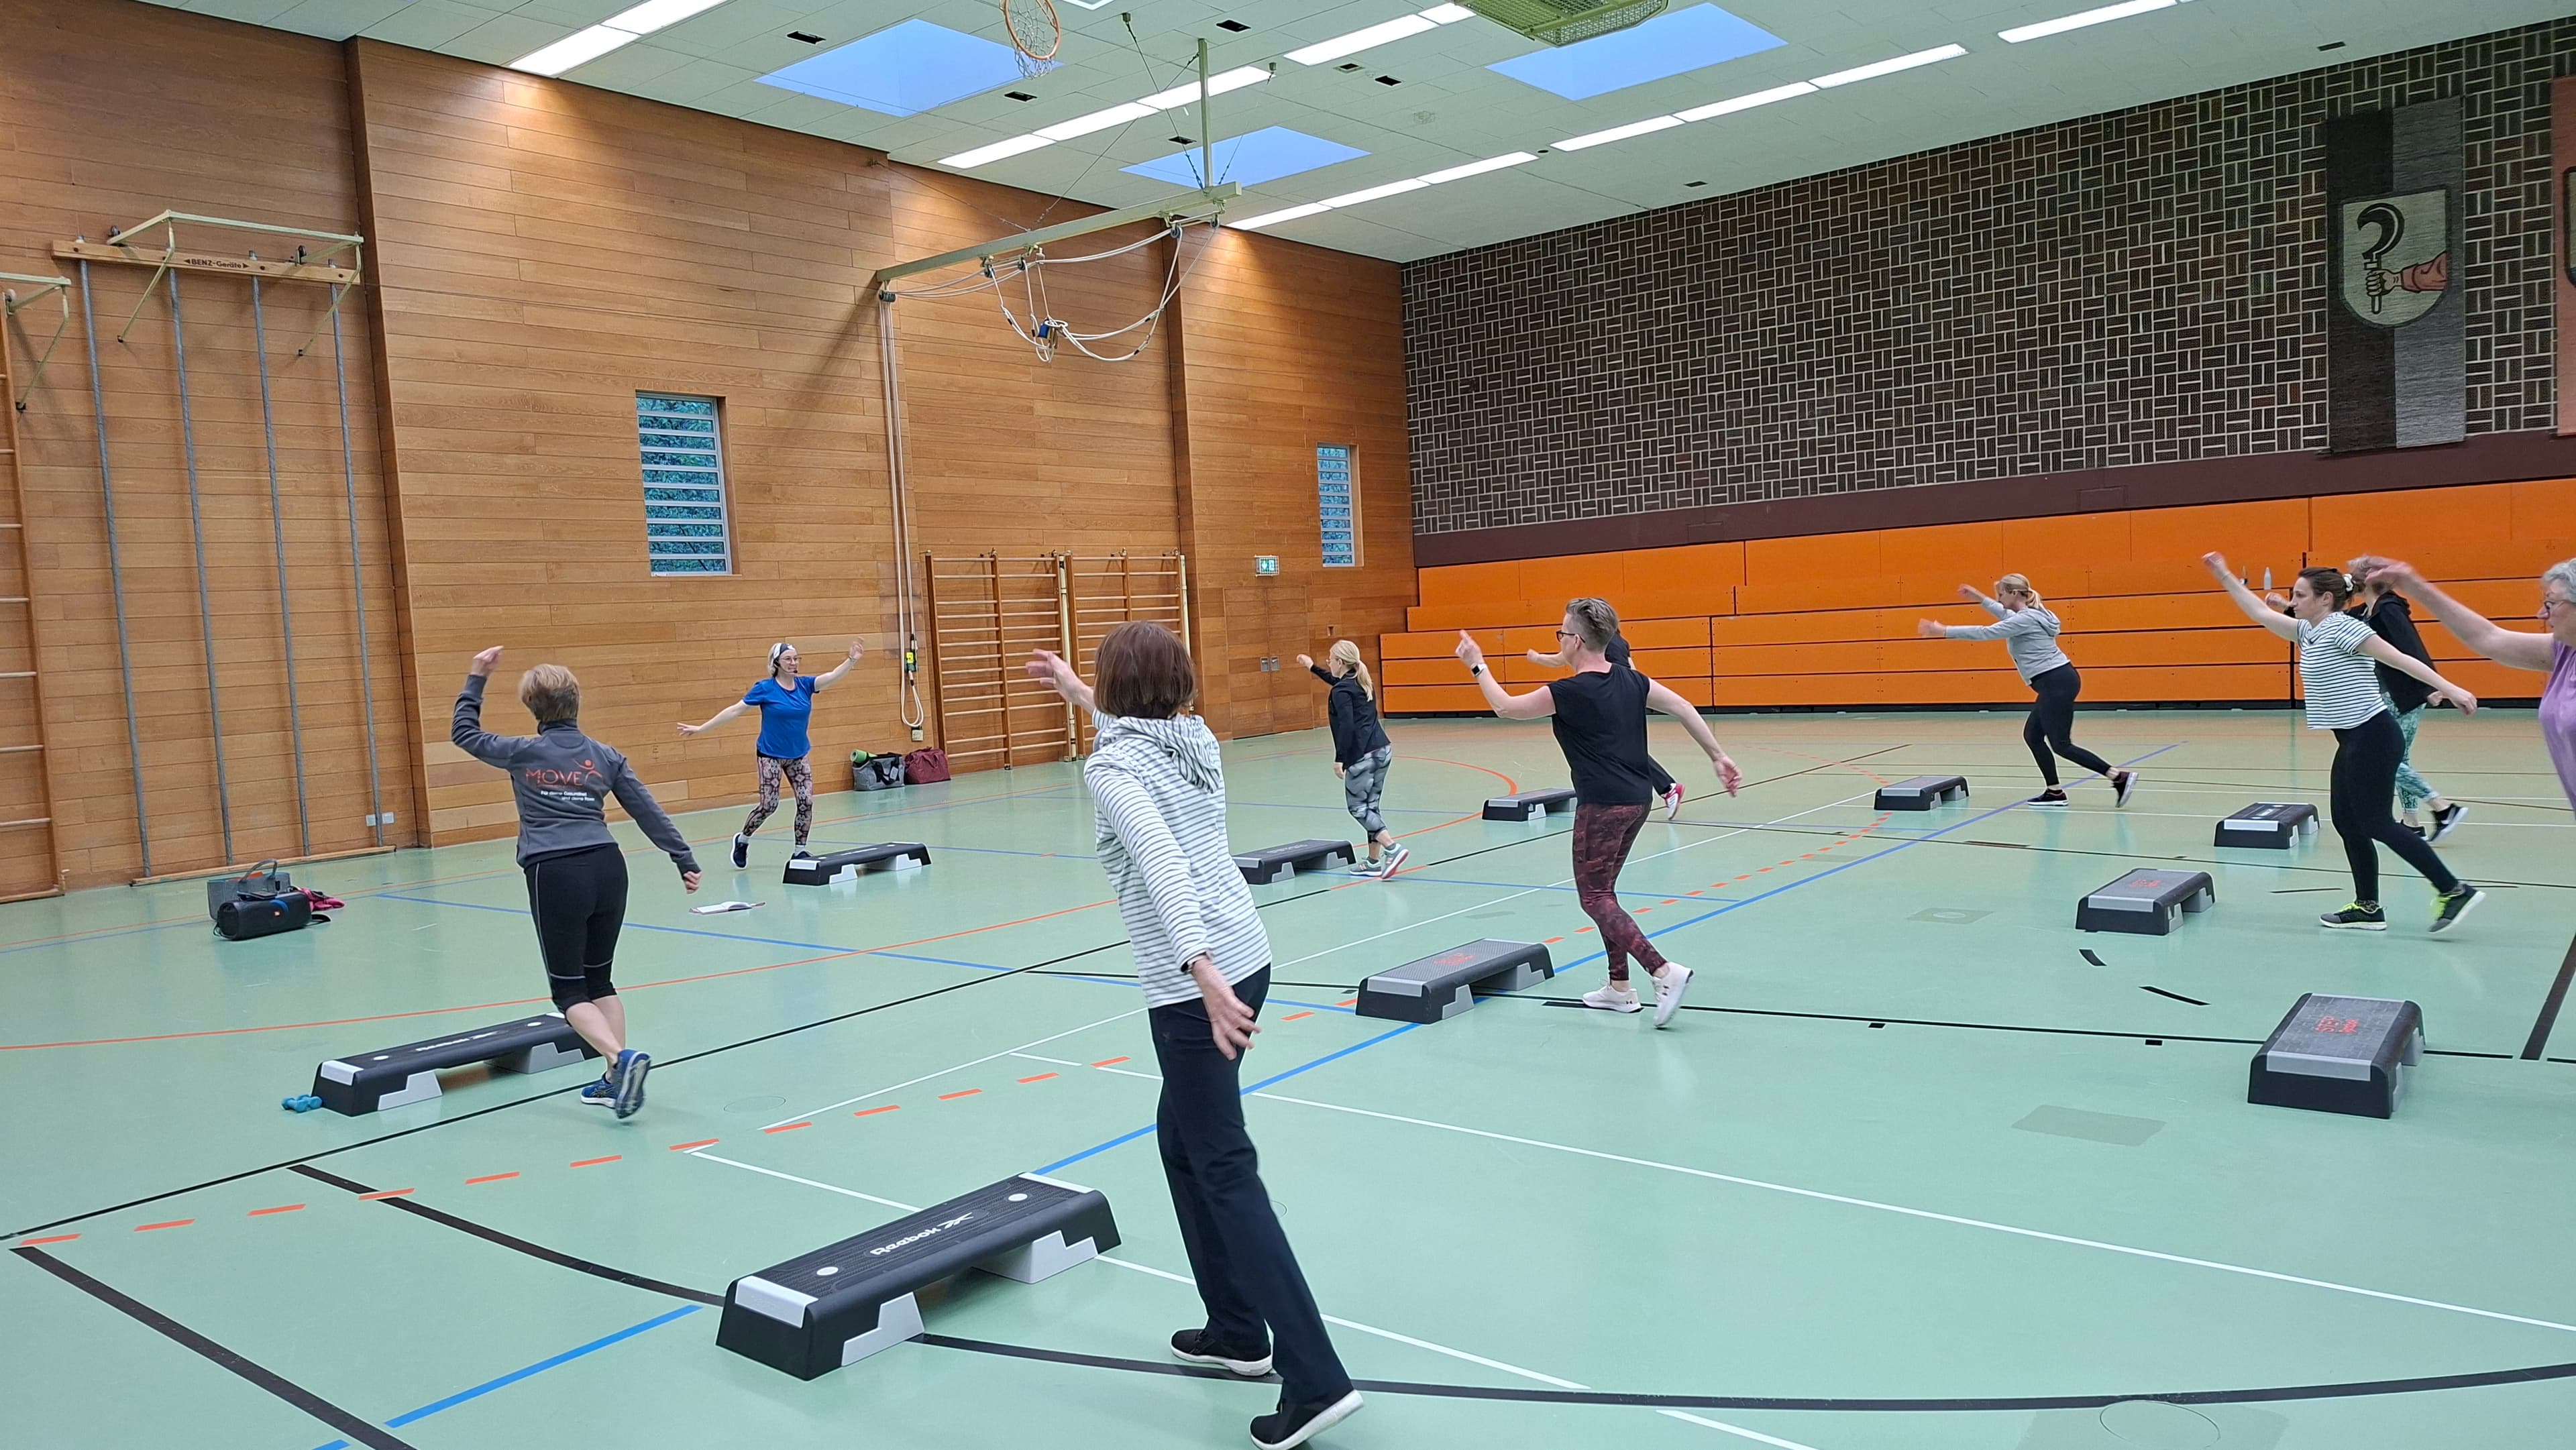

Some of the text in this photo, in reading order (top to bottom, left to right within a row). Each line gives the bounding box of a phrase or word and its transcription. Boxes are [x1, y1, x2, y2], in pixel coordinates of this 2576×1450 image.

[191, 258, 241, 268] BENZ-Geräte
[525, 768, 583, 785] MOVE
[870, 1227, 941, 1256] Reebok
